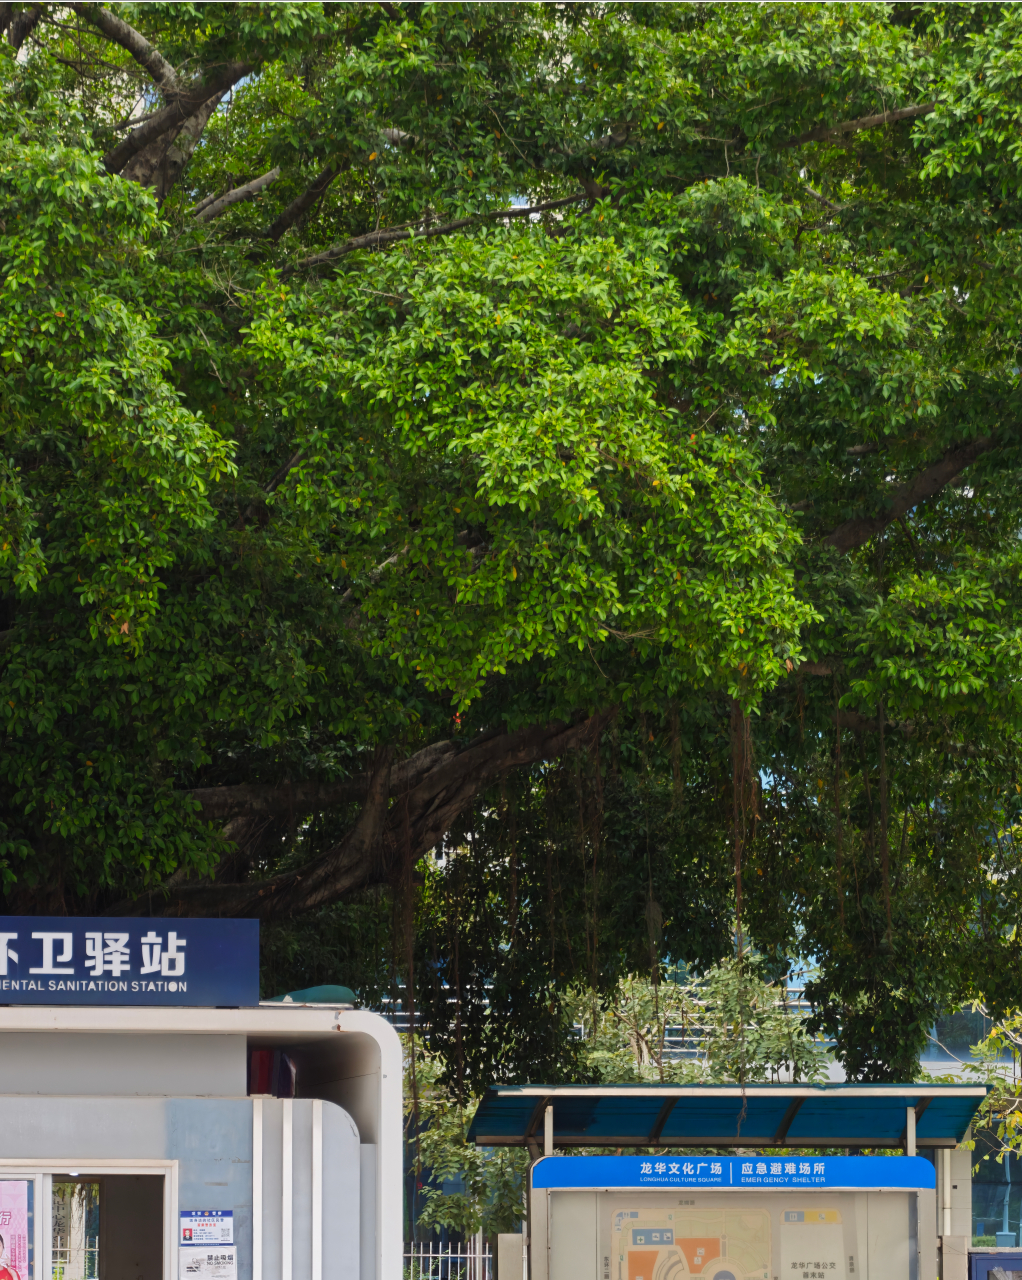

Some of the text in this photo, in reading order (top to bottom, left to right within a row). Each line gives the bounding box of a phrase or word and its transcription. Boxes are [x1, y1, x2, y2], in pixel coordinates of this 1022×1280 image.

[48, 980, 128, 992] SANITATION
[131, 981, 188, 993] STATION
[640, 1162, 825, 1175] 龙华文化广场 应急避难场所
[790, 1261, 837, 1270] 龙华广场公交
